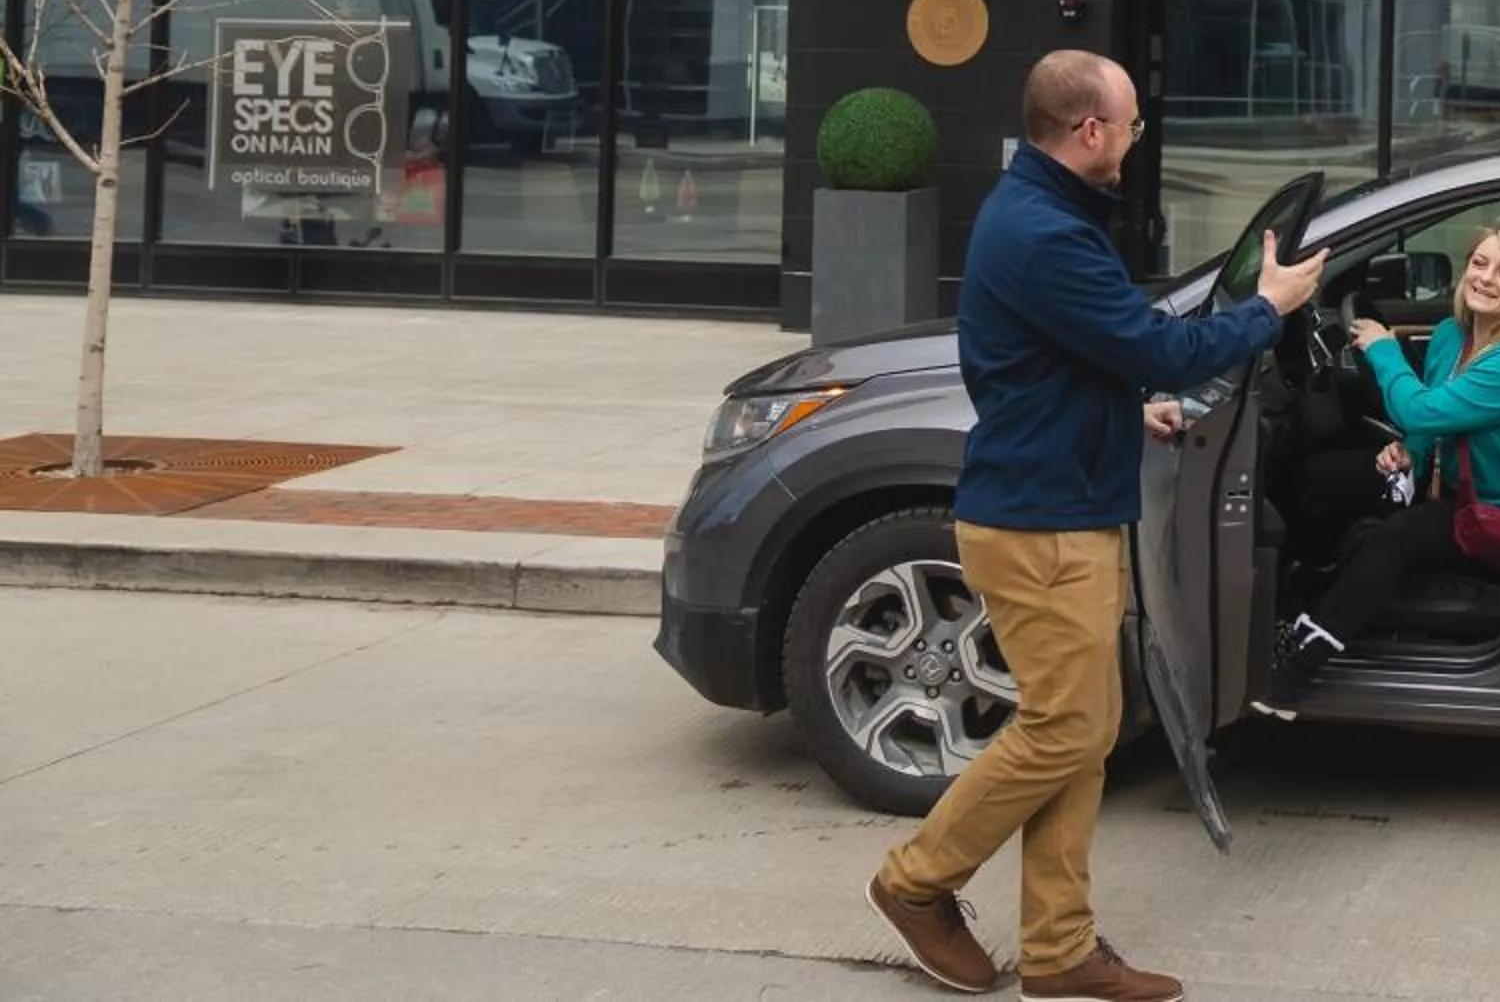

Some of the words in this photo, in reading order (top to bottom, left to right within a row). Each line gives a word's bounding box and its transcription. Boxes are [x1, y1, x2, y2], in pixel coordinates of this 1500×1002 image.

[233, 38, 334, 97] EYE
[233, 99, 334, 133] SPECS
[231, 169, 290, 187] optical
[298, 168, 372, 187] boutique
